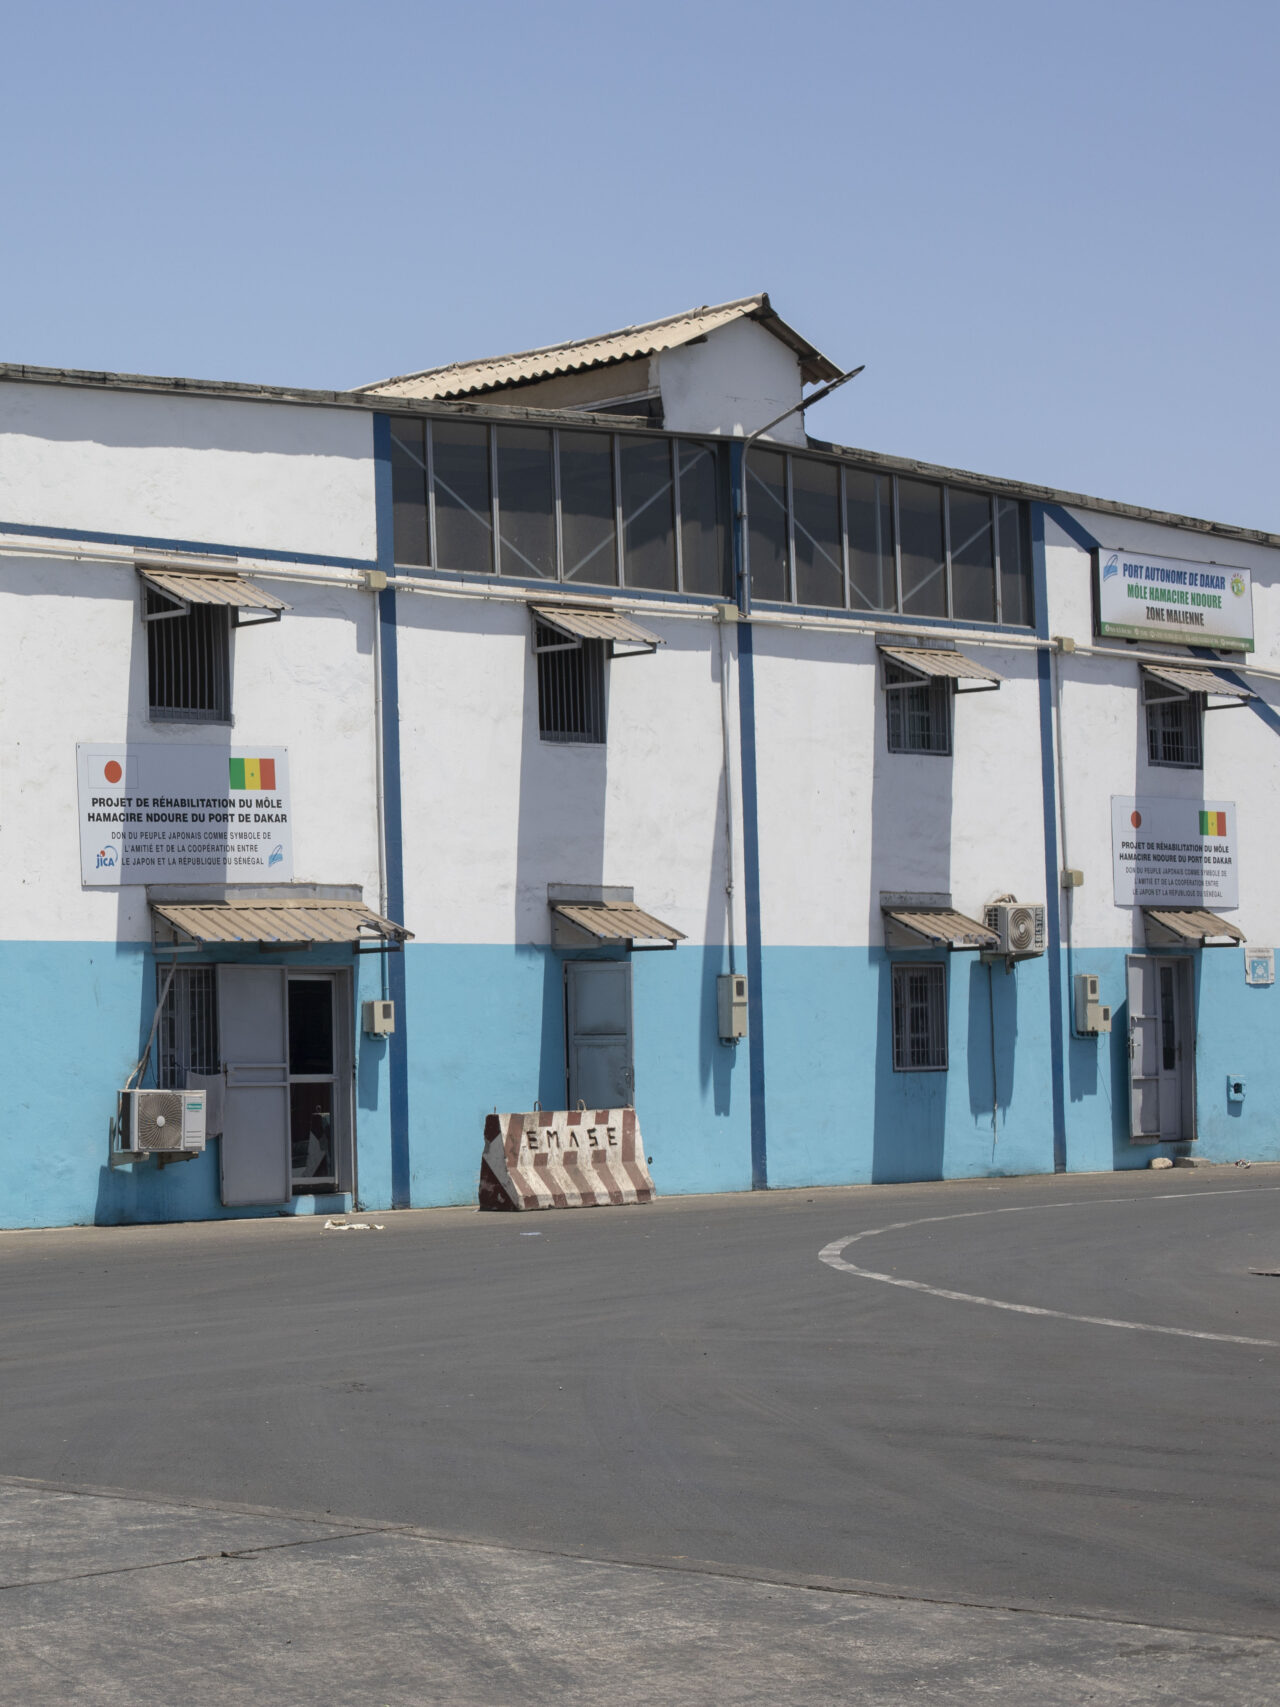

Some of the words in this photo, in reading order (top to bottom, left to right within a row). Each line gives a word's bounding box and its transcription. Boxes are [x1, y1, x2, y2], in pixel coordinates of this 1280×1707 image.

[1123, 563, 1143, 580] PORT
[1145, 567, 1187, 585] AUTONOME
[1189, 573, 1199, 586] DE
[1200, 574, 1226, 590] DAKAR
[1127, 583, 1148, 600] MÔLE
[1149, 587, 1189, 605] HAMACIRE
[1191, 592, 1222, 609] NDOURE
[1146, 606, 1165, 621] ZONE
[1166, 609, 1204, 626] MALIENNE
[91, 797, 133, 807] PROJET
[136, 798, 149, 807] DE
[152, 796, 235, 808] RÉHABILITATION
[239, 799, 252, 808] DU
[255, 796, 282, 808] MÔLE
[88, 813, 143, 822] HAMACIRE
[146, 813, 188, 822] NDOURE
[191, 813, 205, 823] DU
[208, 813, 235, 823] PORT
[238, 814, 251, 823] DE
[254, 814, 287, 823] DAKAR
[111, 832, 126, 840] DON
[128, 832, 137, 840] DU
[140, 832, 166, 840] PEUPLE
[168, 832, 201, 840] JAPONAIS
[203, 832, 227, 840] COMME
[230, 832, 260, 840] SYMBOLE
[263, 832, 271, 840] DE
[125, 843, 153, 853] L'AMITIÉ
[156, 845, 164, 853] ET
[166, 845, 175, 853] DE
[177, 845, 186, 853] LA
[188, 843, 235, 853] COOPÉRATION
[237, 845, 258, 853] ENTRE
[1122, 841, 1145, 850] PROJET
[1147, 842, 1154, 850] DE
[122, 857, 130, 865] LE
[132, 857, 155, 865] JAPON
[157, 857, 165, 865] ET
[168, 857, 176, 865] LA
[179, 856, 220, 866] RÉPUBLIQUE
[223, 857, 232, 866] DU
[234, 856, 264, 866] SÉNÉGAL
[1120, 853, 1151, 861] HAMACIRE
[1152, 854, 1177, 862] NDOURE
[1178, 855, 1186, 863] DU
[1188, 855, 1202, 863] PORT
[1204, 856, 1211, 864] DE
